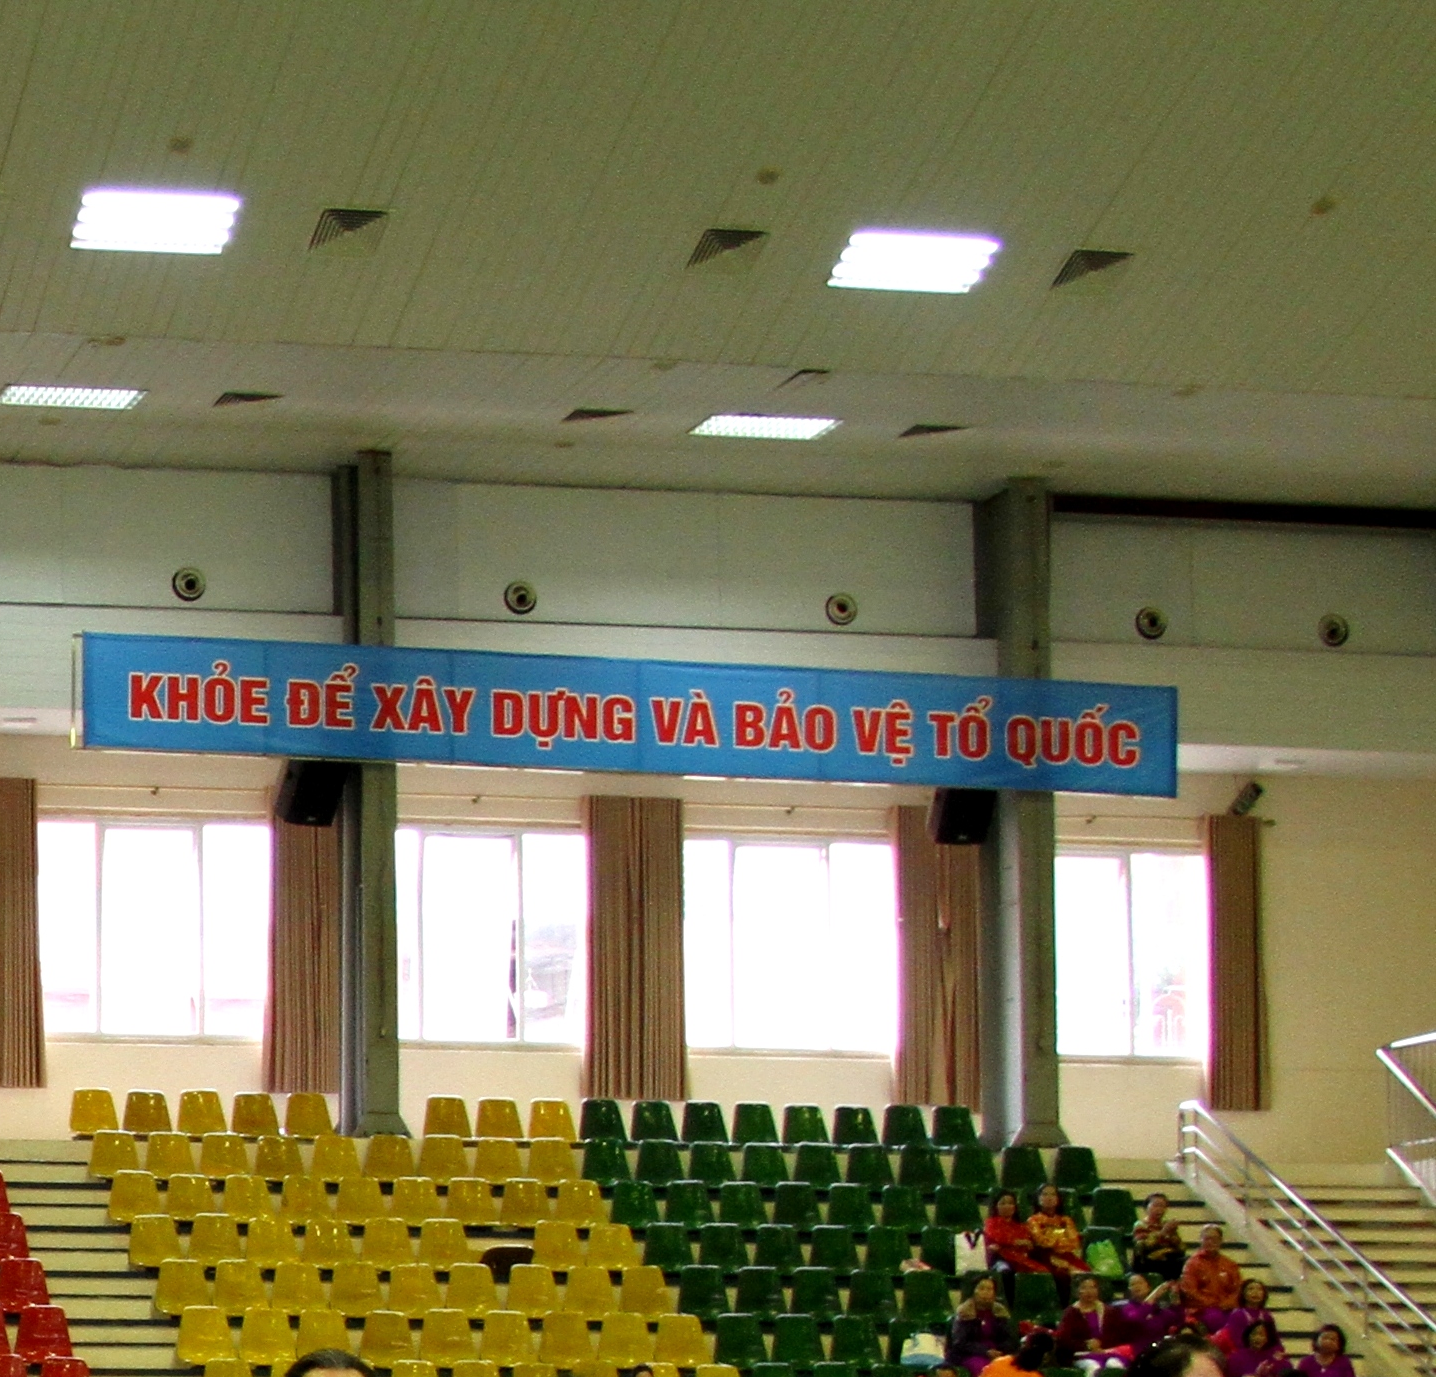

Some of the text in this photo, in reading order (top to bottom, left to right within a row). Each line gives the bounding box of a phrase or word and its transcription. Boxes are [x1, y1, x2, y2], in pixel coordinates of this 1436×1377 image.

[128, 660, 1141, 768] KHỎE ĐỂ XÂY DỰNG VÀ BẢO VỆ TỔ QUỐC
